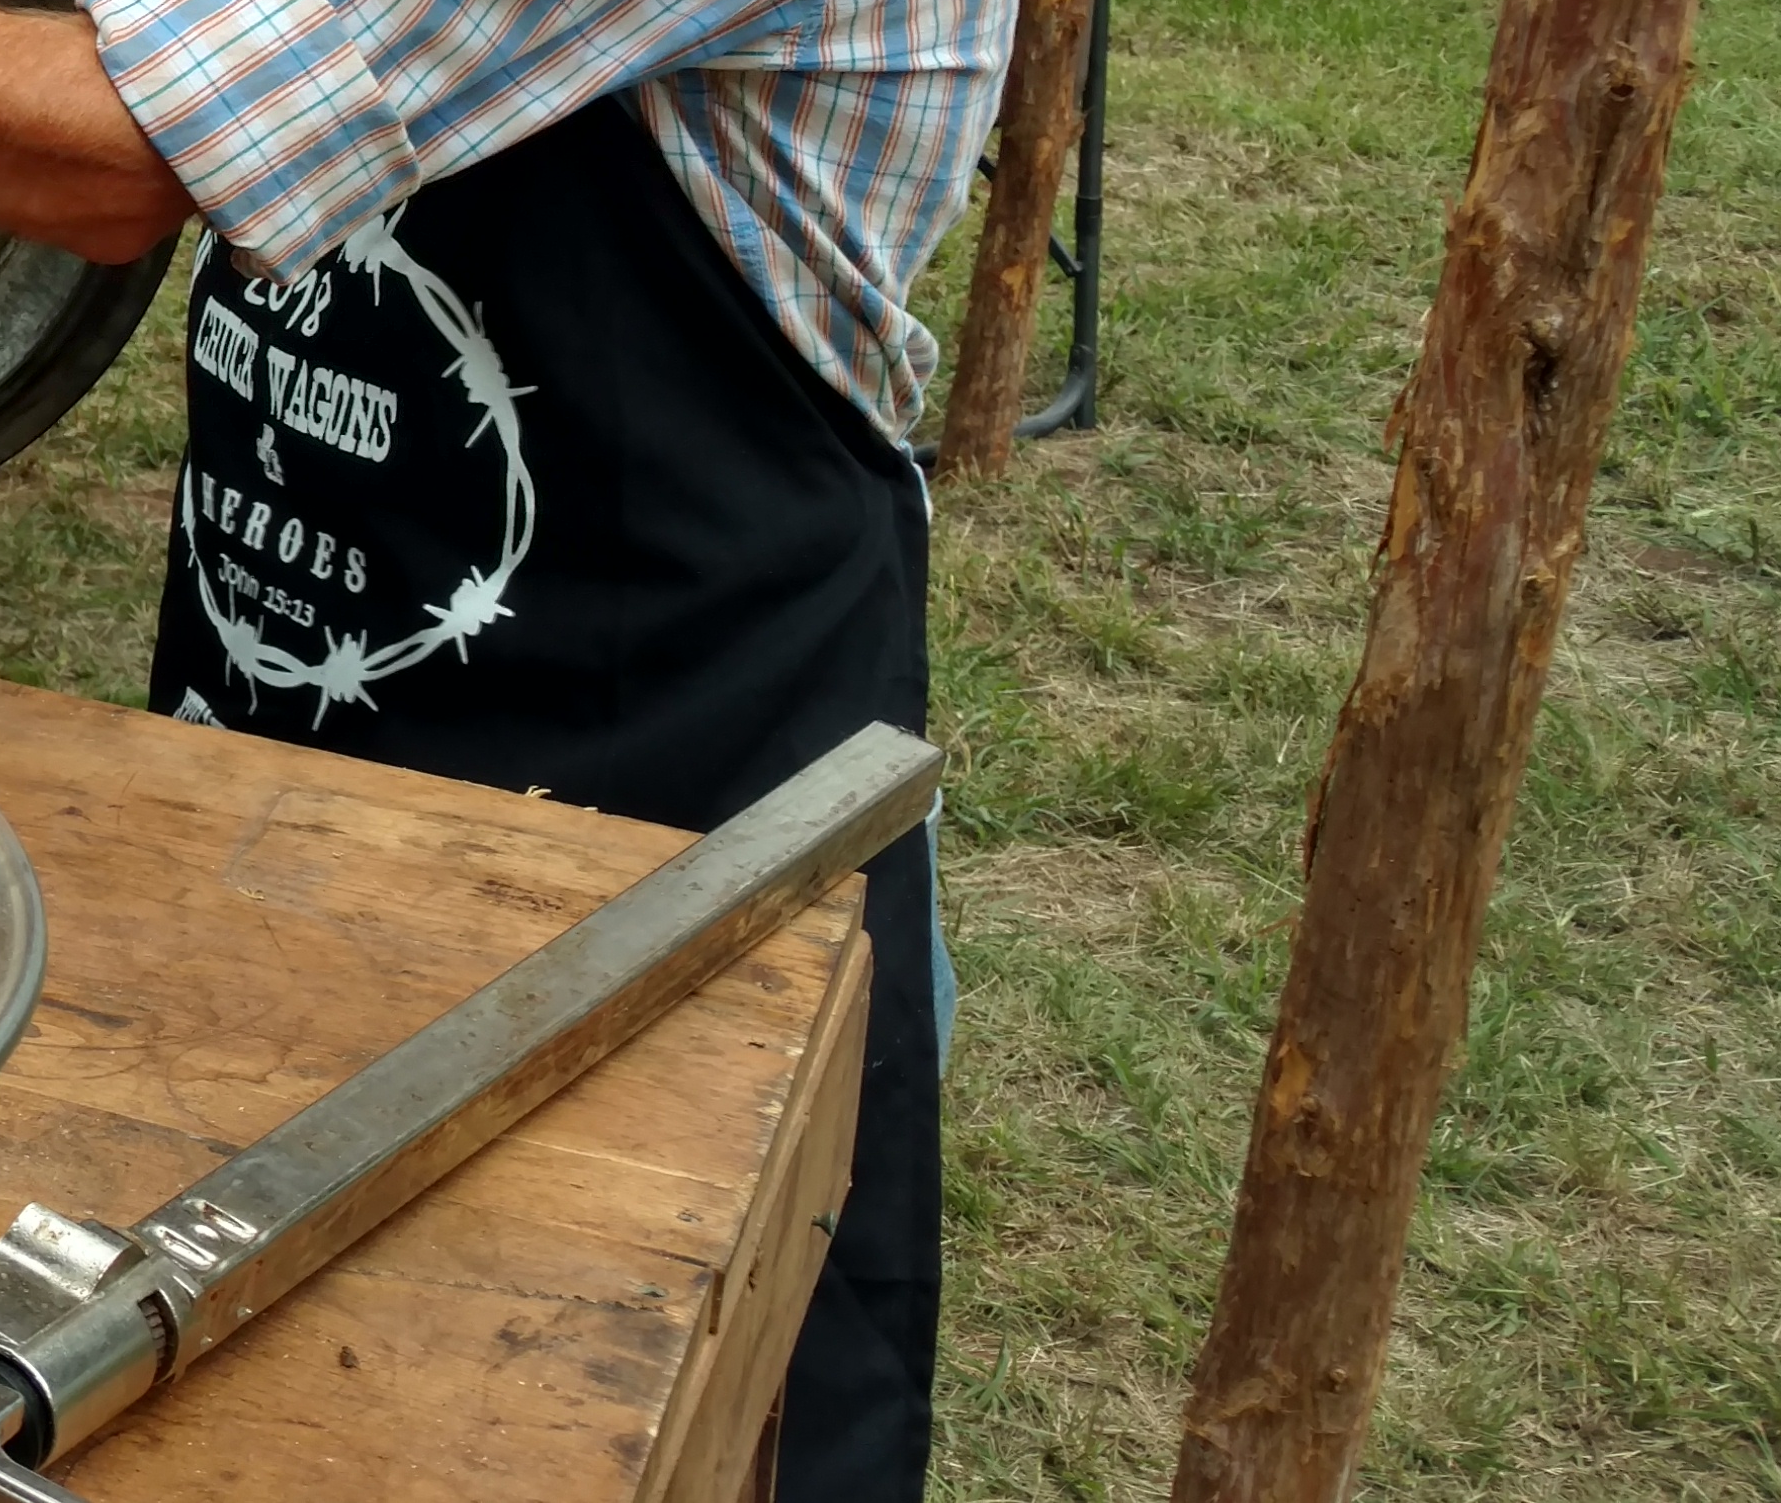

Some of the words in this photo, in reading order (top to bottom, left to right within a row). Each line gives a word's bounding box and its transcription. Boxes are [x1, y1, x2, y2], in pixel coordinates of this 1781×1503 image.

[193, 295, 259, 403] CHUCK
[266, 345, 398, 463] WAGONS
[201, 471, 367, 594] HEROES
[218, 553, 260, 600] John
[262, 585, 316, 628] 15:13
